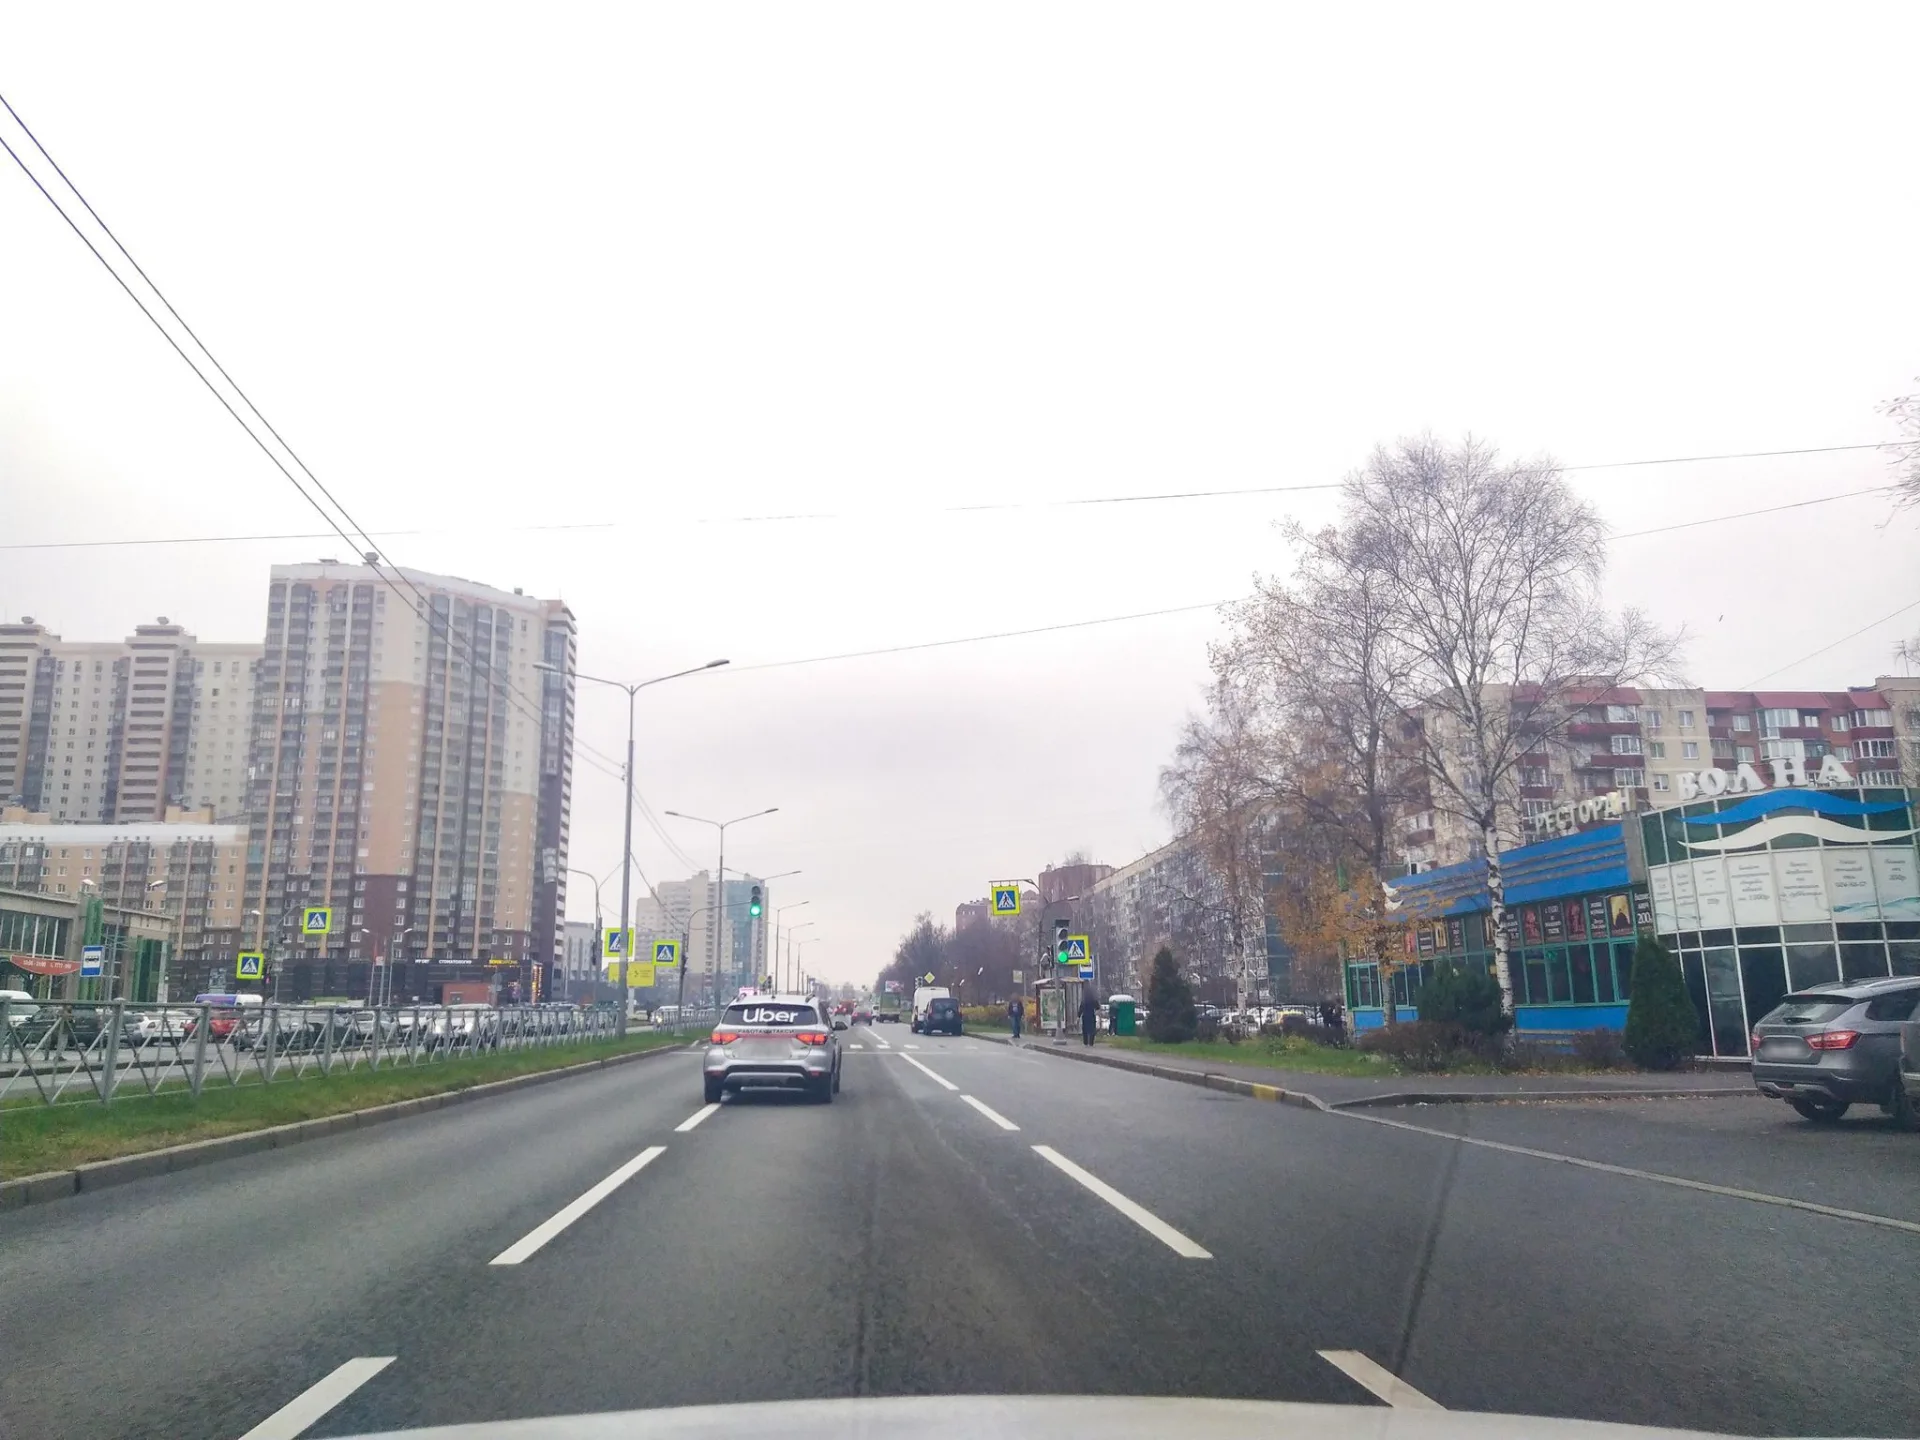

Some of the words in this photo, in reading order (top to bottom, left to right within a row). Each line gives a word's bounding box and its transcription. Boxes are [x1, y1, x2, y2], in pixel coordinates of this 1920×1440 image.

[1676, 754, 1854, 801] ВОЛНА
[1535, 786, 1632, 835] РЕСТОРАН
[742, 1007, 799, 1023] Uber
